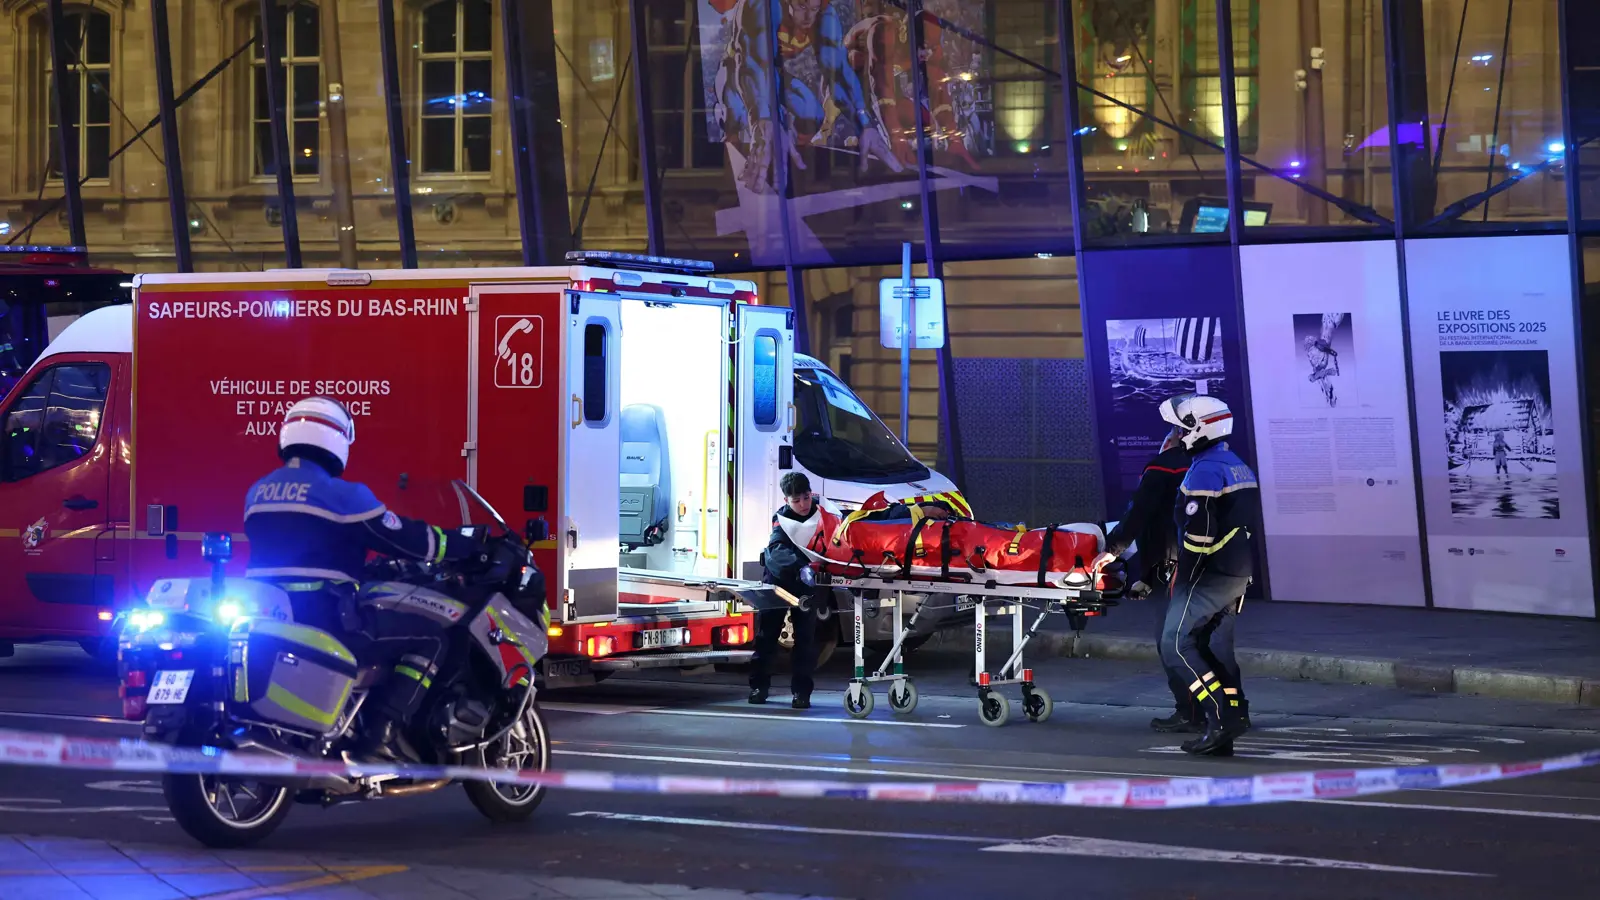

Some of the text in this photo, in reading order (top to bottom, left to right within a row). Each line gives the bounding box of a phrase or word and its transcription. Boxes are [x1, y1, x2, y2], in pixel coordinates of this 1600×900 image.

[149, 298, 458, 318] SAPEURS-POMPIERS DU BAS-RHIN
[1437, 309, 1511, 321] LE LIVRE DES
[1438, 322, 1547, 334] EXPOSITIONS 2025
[507, 352, 534, 386] 18
[209, 377, 391, 396] VÉHICULE DE SECOURS
[236, 401, 256, 415] ET
[245, 421, 277, 436] AUX
[253, 482, 311, 503] POLICE
